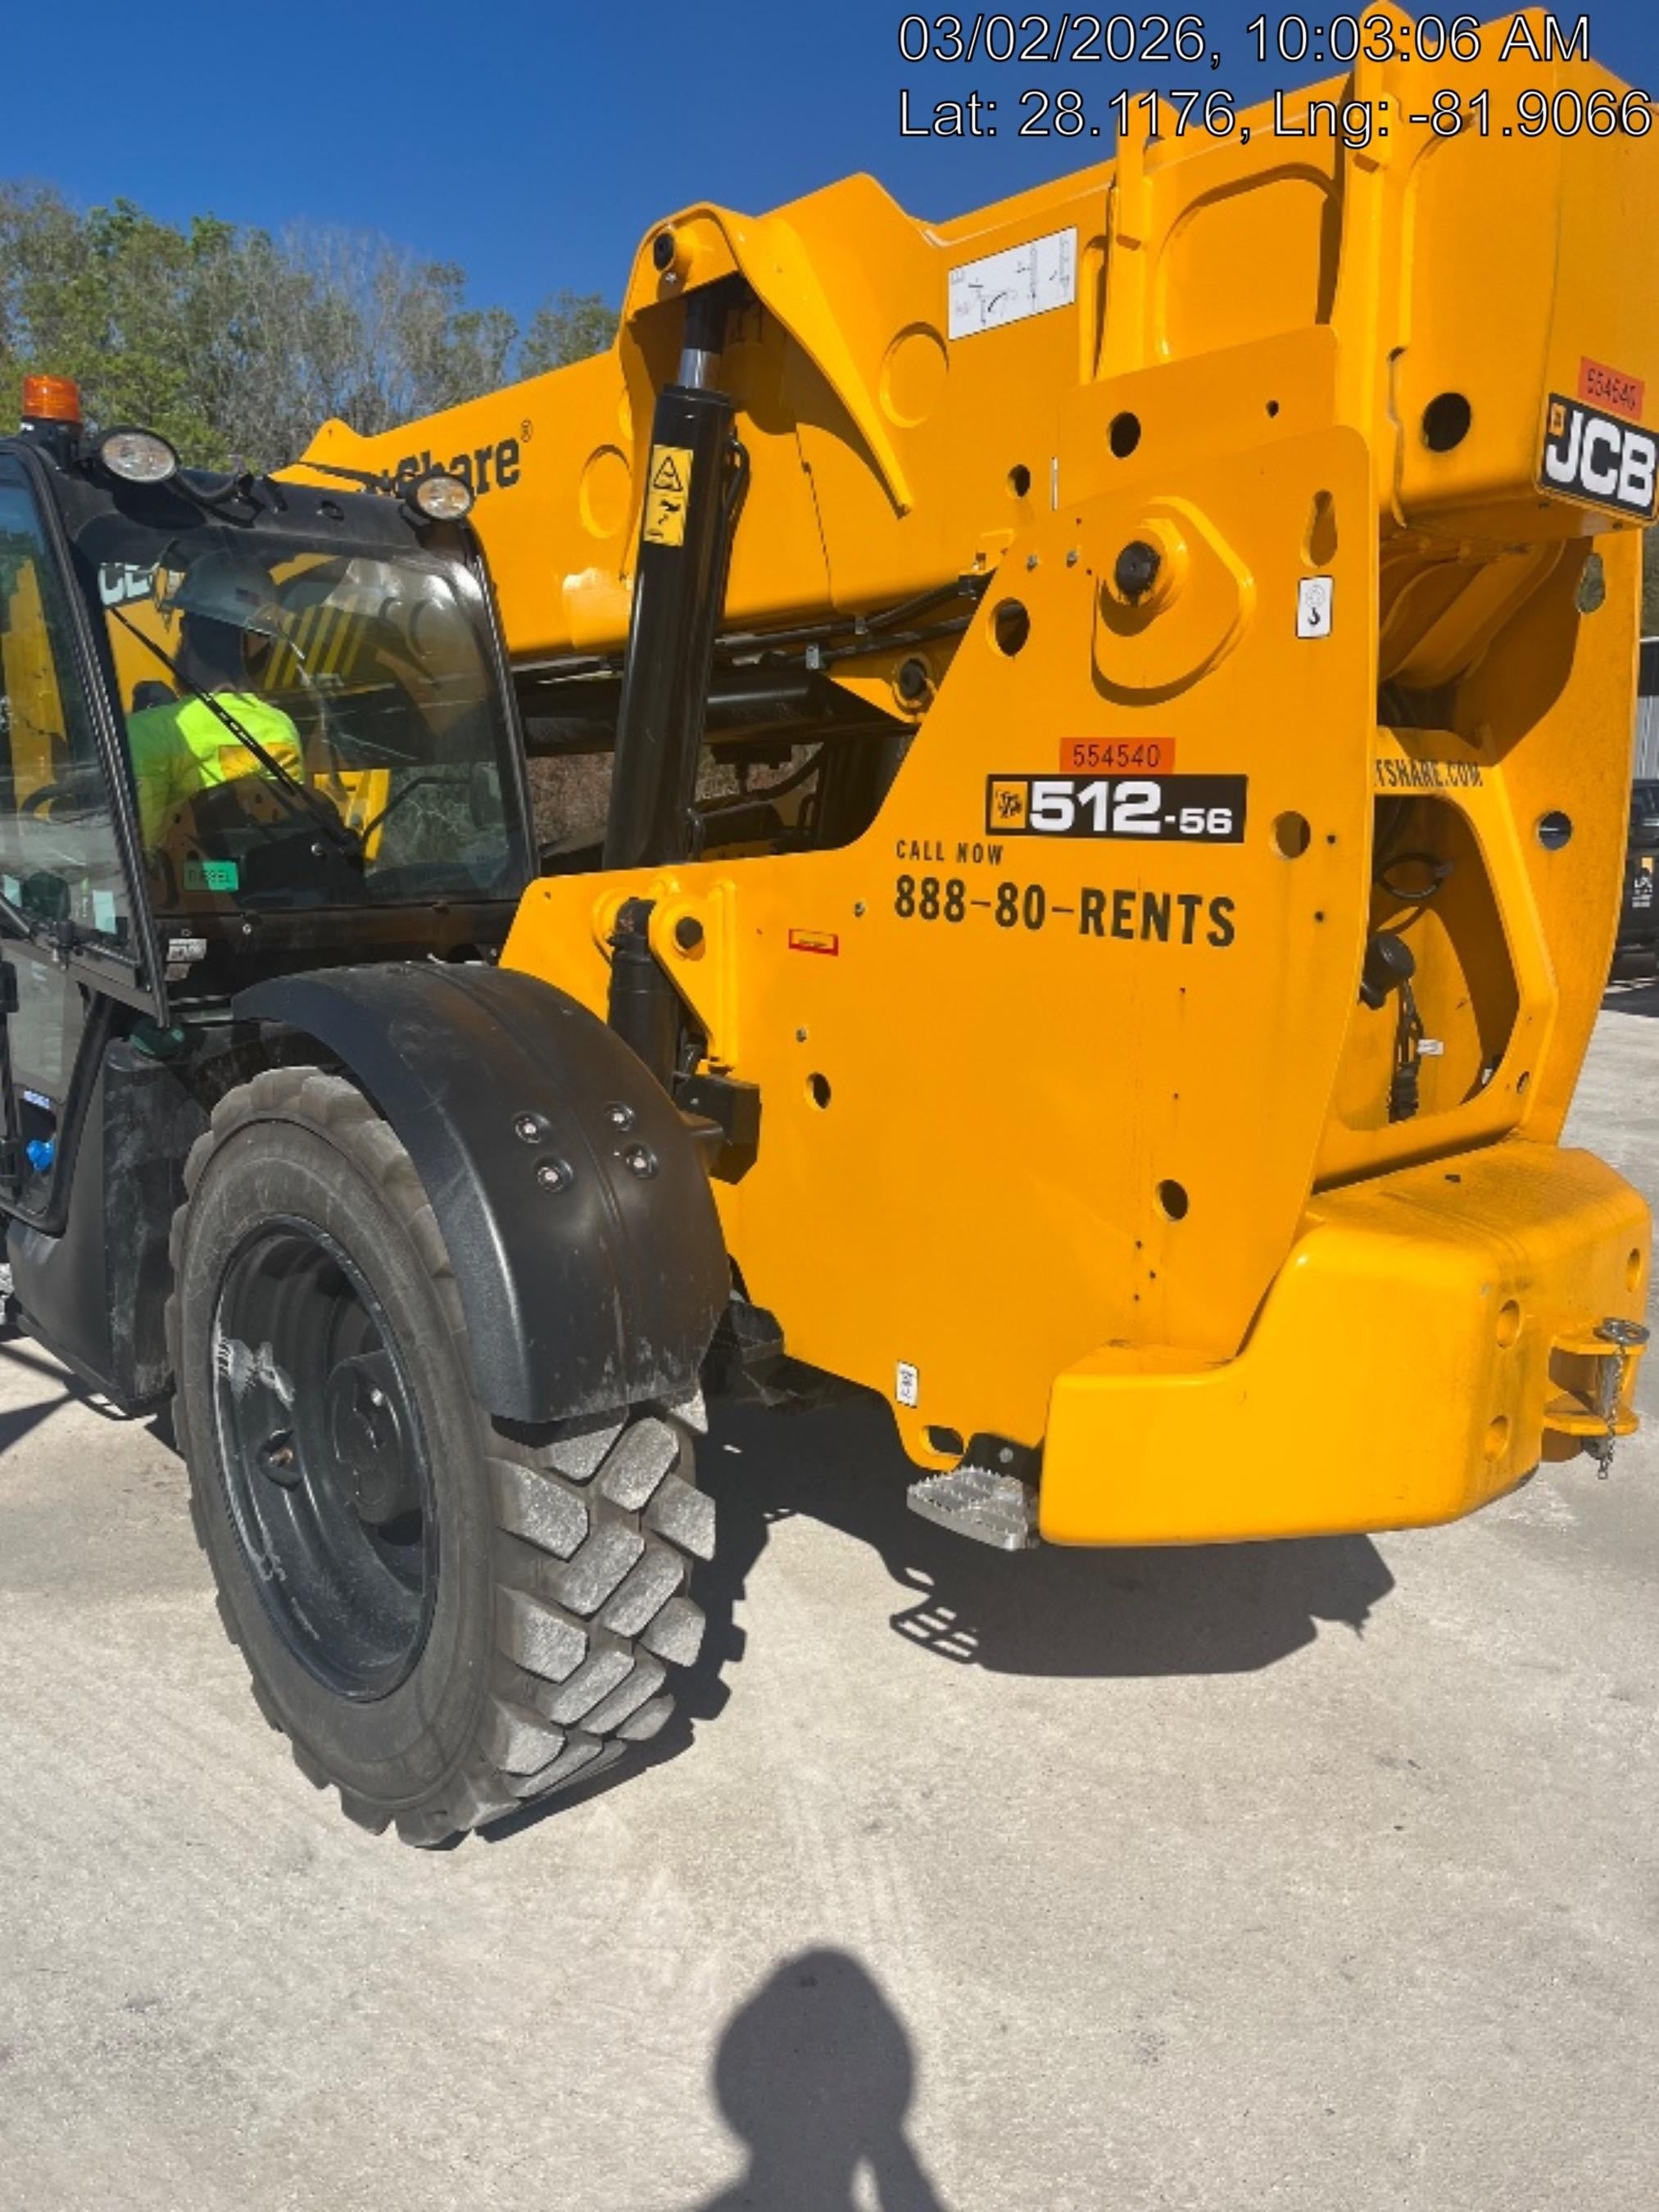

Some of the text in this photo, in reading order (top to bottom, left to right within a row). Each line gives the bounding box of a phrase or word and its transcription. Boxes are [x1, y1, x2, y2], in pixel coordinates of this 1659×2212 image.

[1545, 410, 1656, 507] JCB
[1072, 744, 1161, 768] 554540
[1029, 781, 1233, 835] 512-56
[896, 840, 1004, 866] CALL NOW
[894, 873, 1235, 948] 888-80-RENTS
